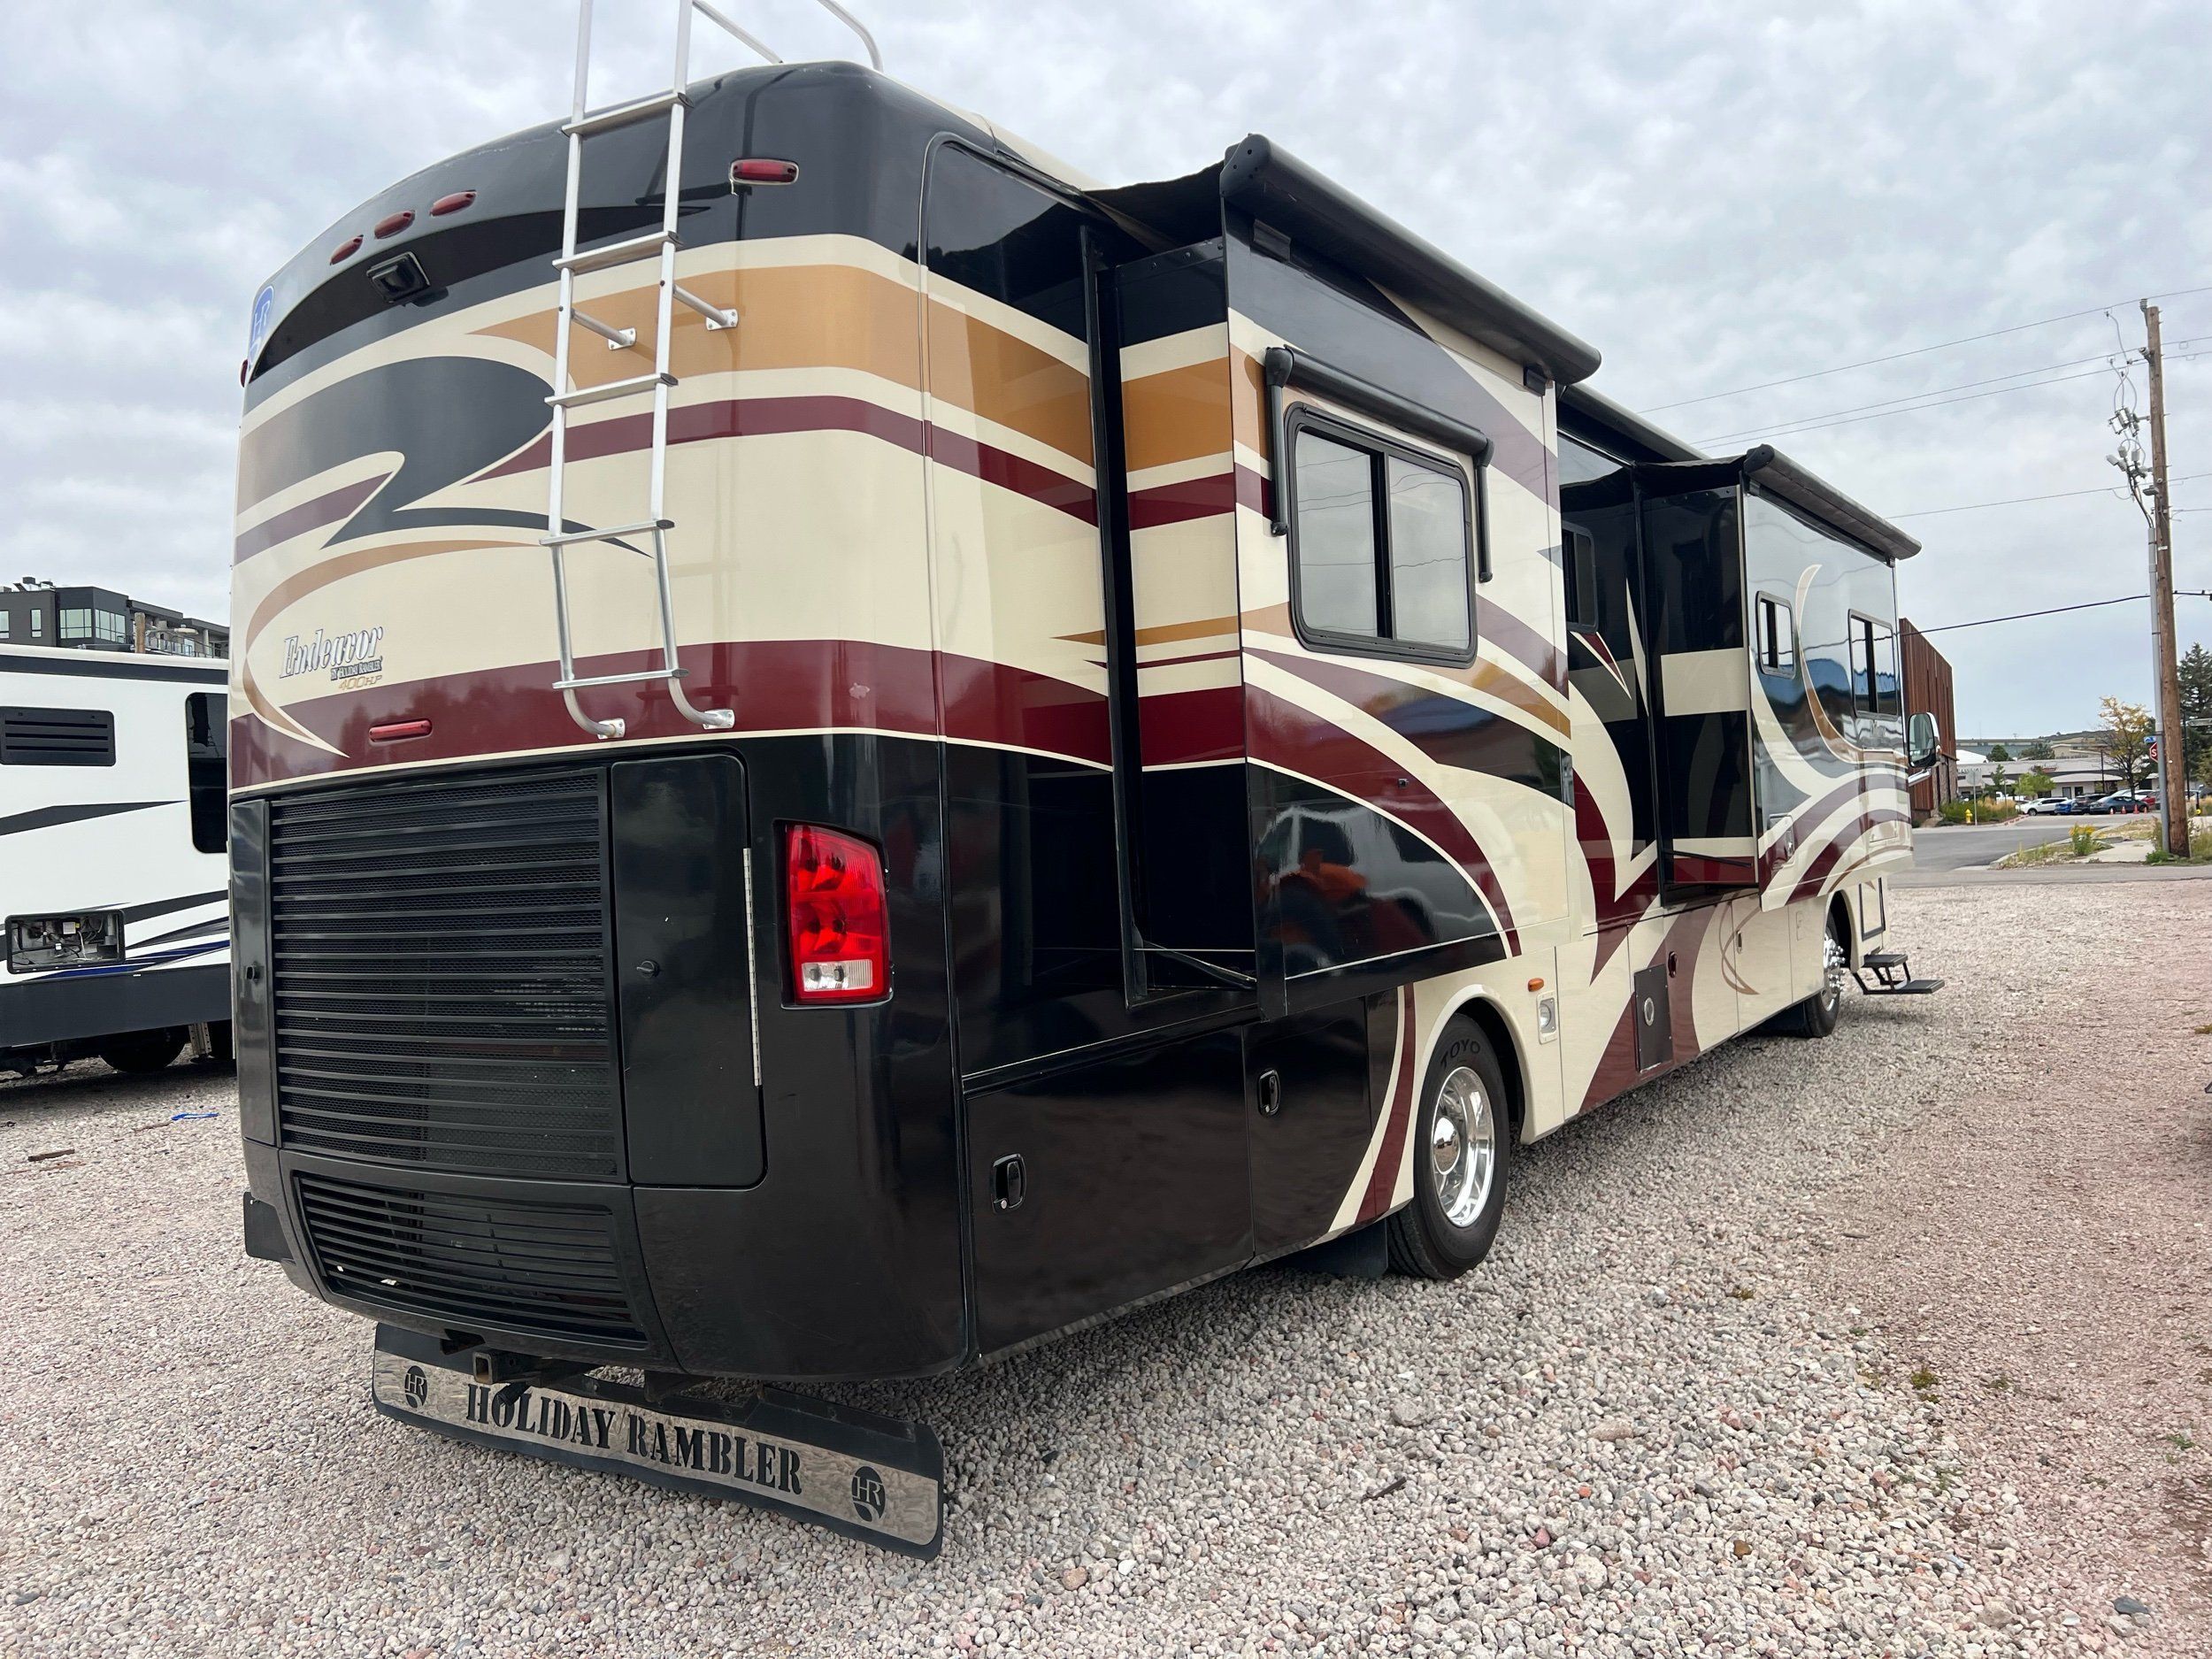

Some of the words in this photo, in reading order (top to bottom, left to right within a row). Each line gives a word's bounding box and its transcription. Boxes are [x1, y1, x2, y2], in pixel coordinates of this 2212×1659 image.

[279, 626, 383, 678] Endeavor
[1440, 1039, 1481, 1068] TOYO
[465, 1383, 615, 1449] HOLIDAY
[627, 1413, 802, 1495] RAMBLER
